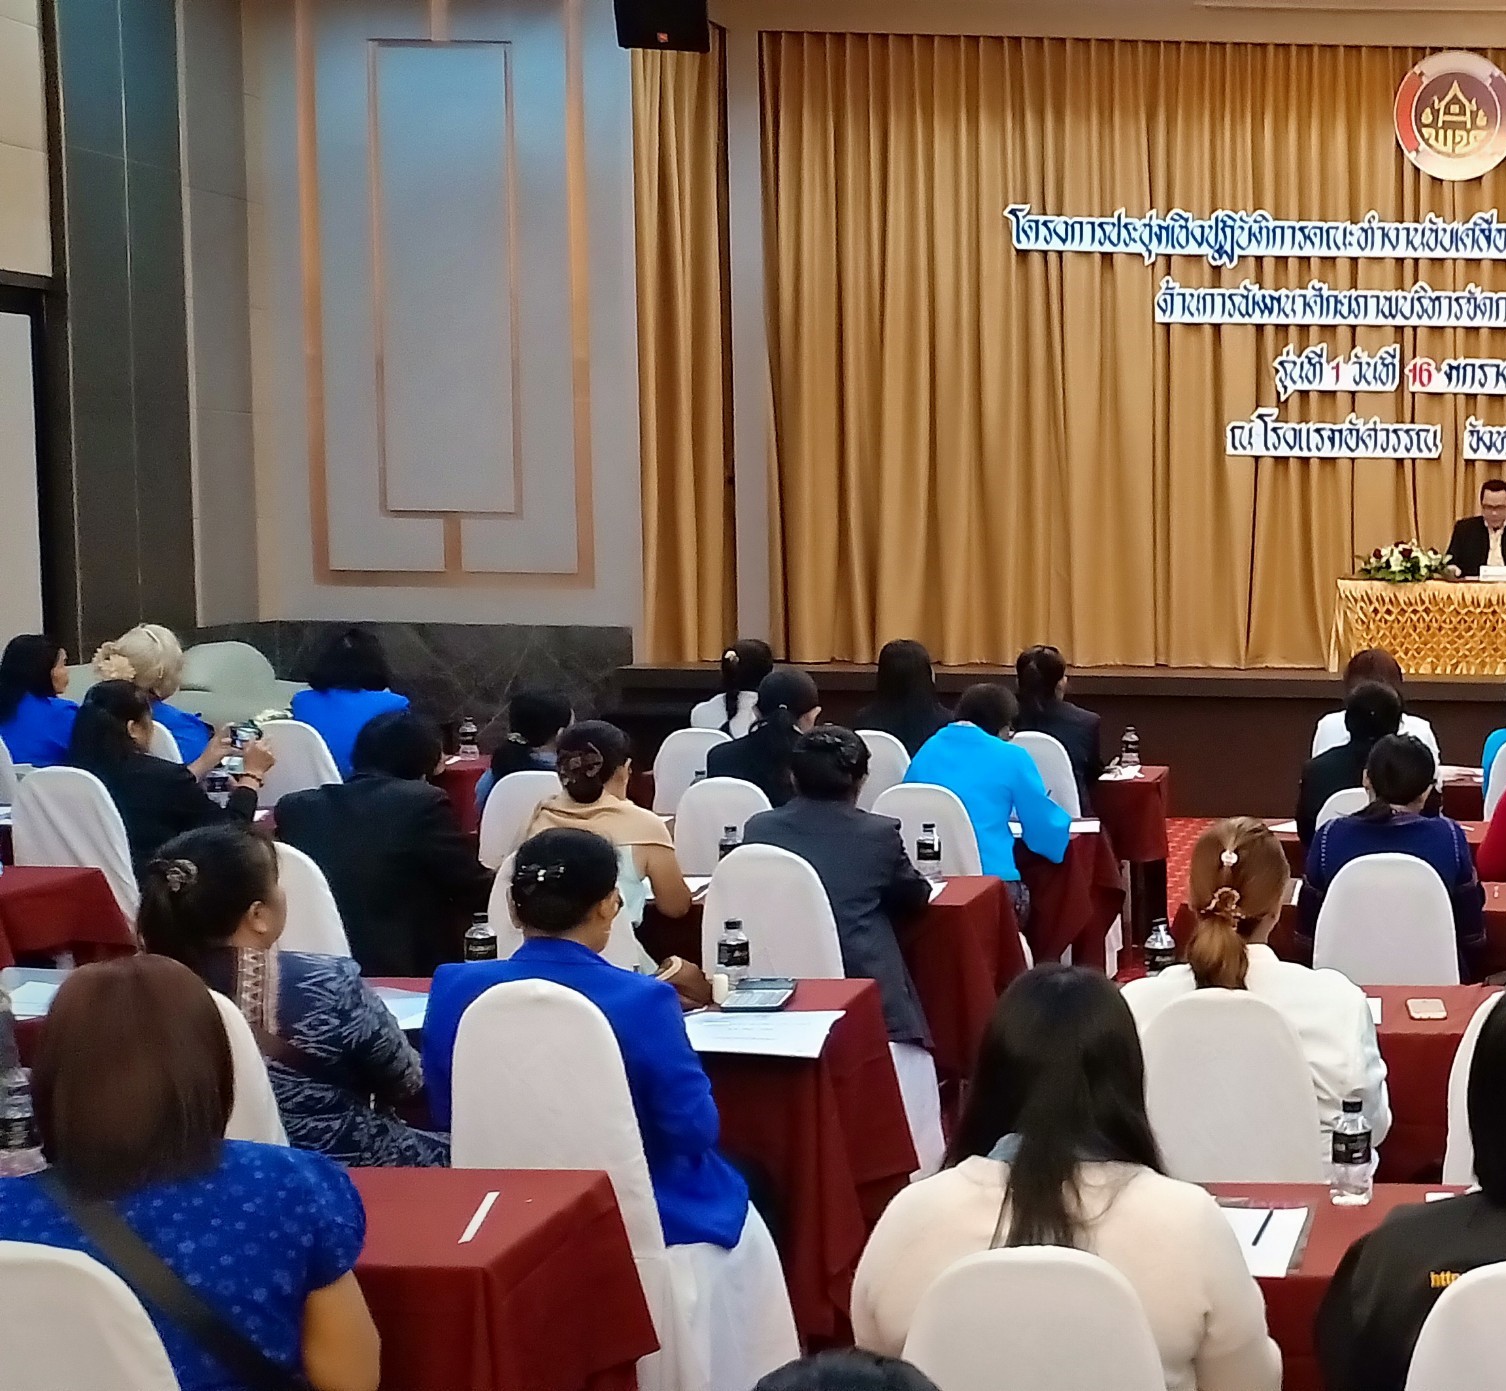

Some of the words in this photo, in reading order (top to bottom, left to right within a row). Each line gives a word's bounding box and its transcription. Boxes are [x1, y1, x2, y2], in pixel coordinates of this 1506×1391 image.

[1276, 346, 1325, 396] รุ่นที่
[1331, 359, 1342, 387] 1
[1352, 346, 1398, 388] วันที่
[1408, 360, 1433, 388] 16
